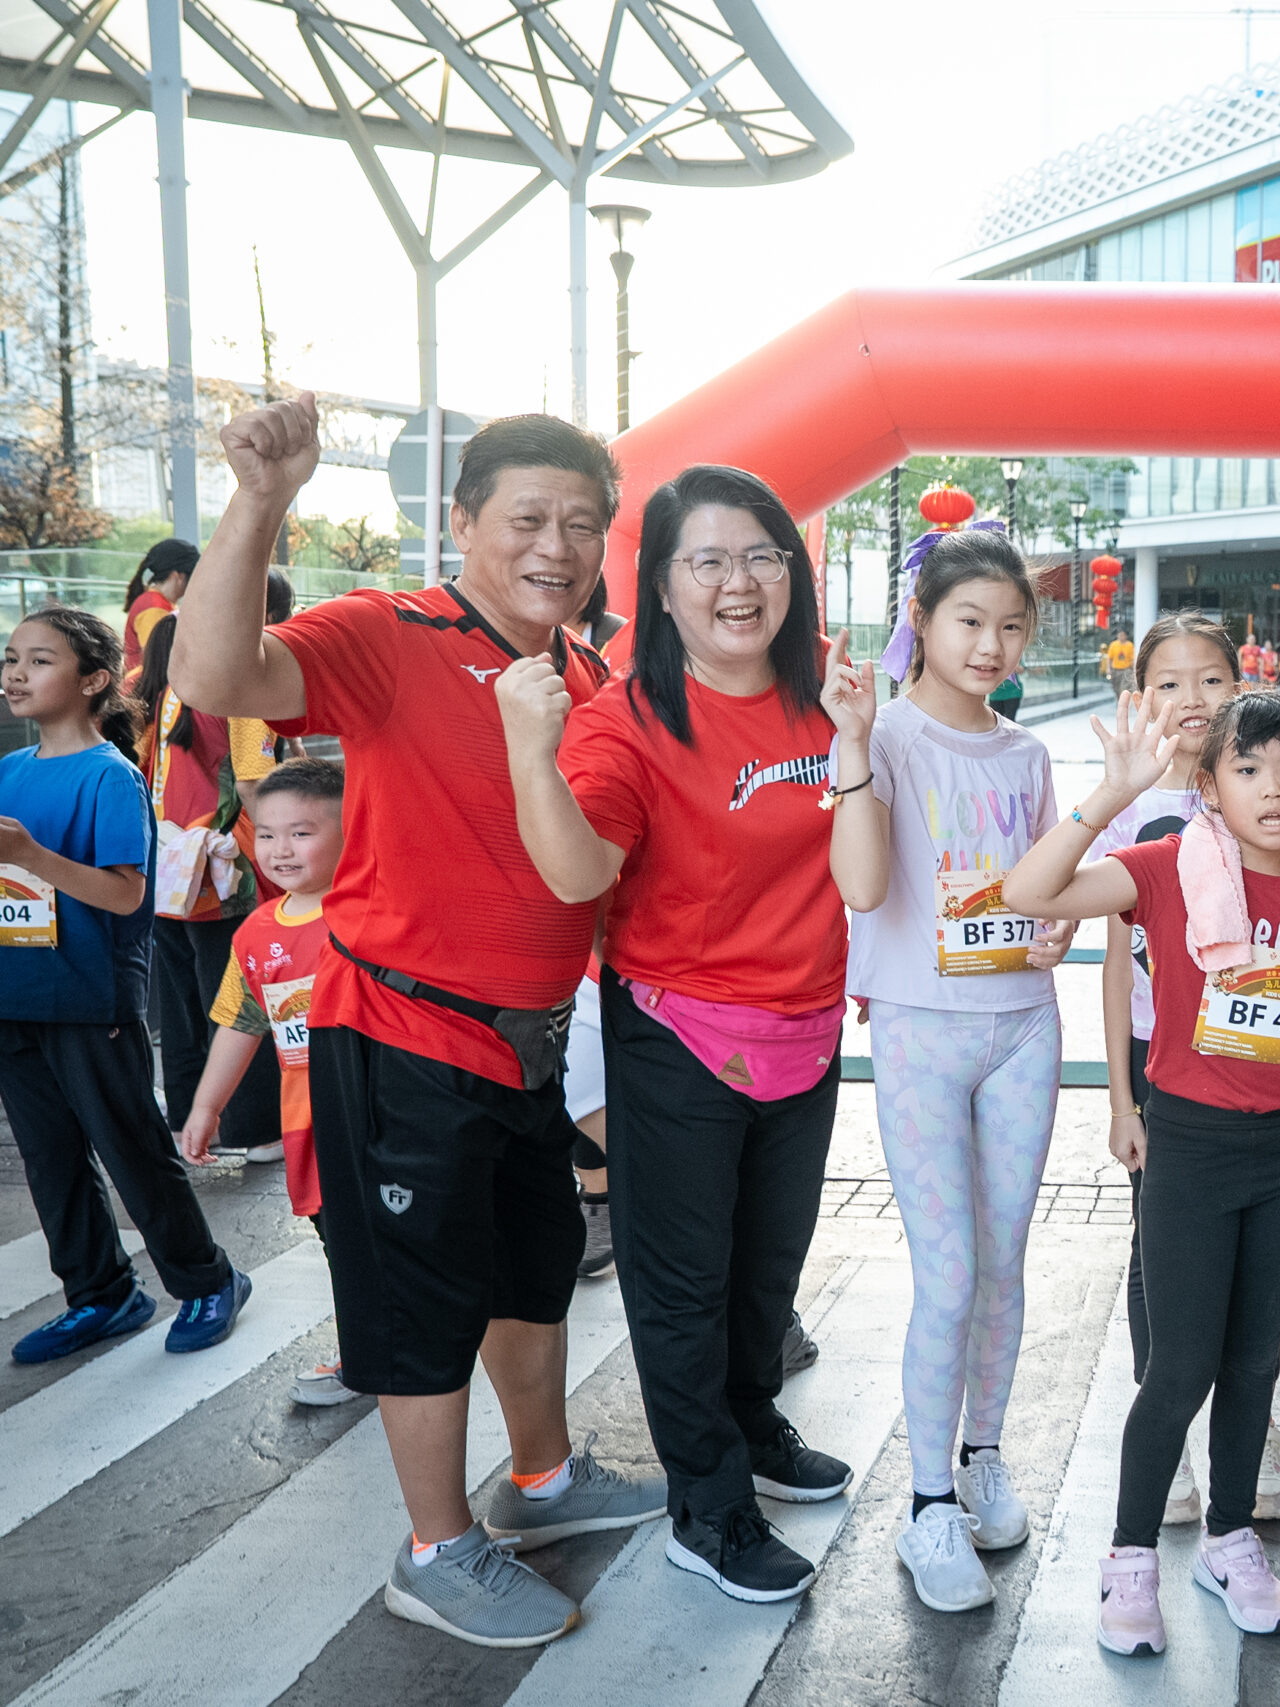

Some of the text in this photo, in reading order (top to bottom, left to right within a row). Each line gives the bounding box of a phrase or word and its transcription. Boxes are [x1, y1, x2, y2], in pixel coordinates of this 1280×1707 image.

[927, 789, 1034, 840] LOVE
[0, 905, 31, 922] 04
[963, 920, 1034, 945] BF 377
[1228, 1000, 1267, 1027] BF
[285, 1024, 308, 1044] AF
